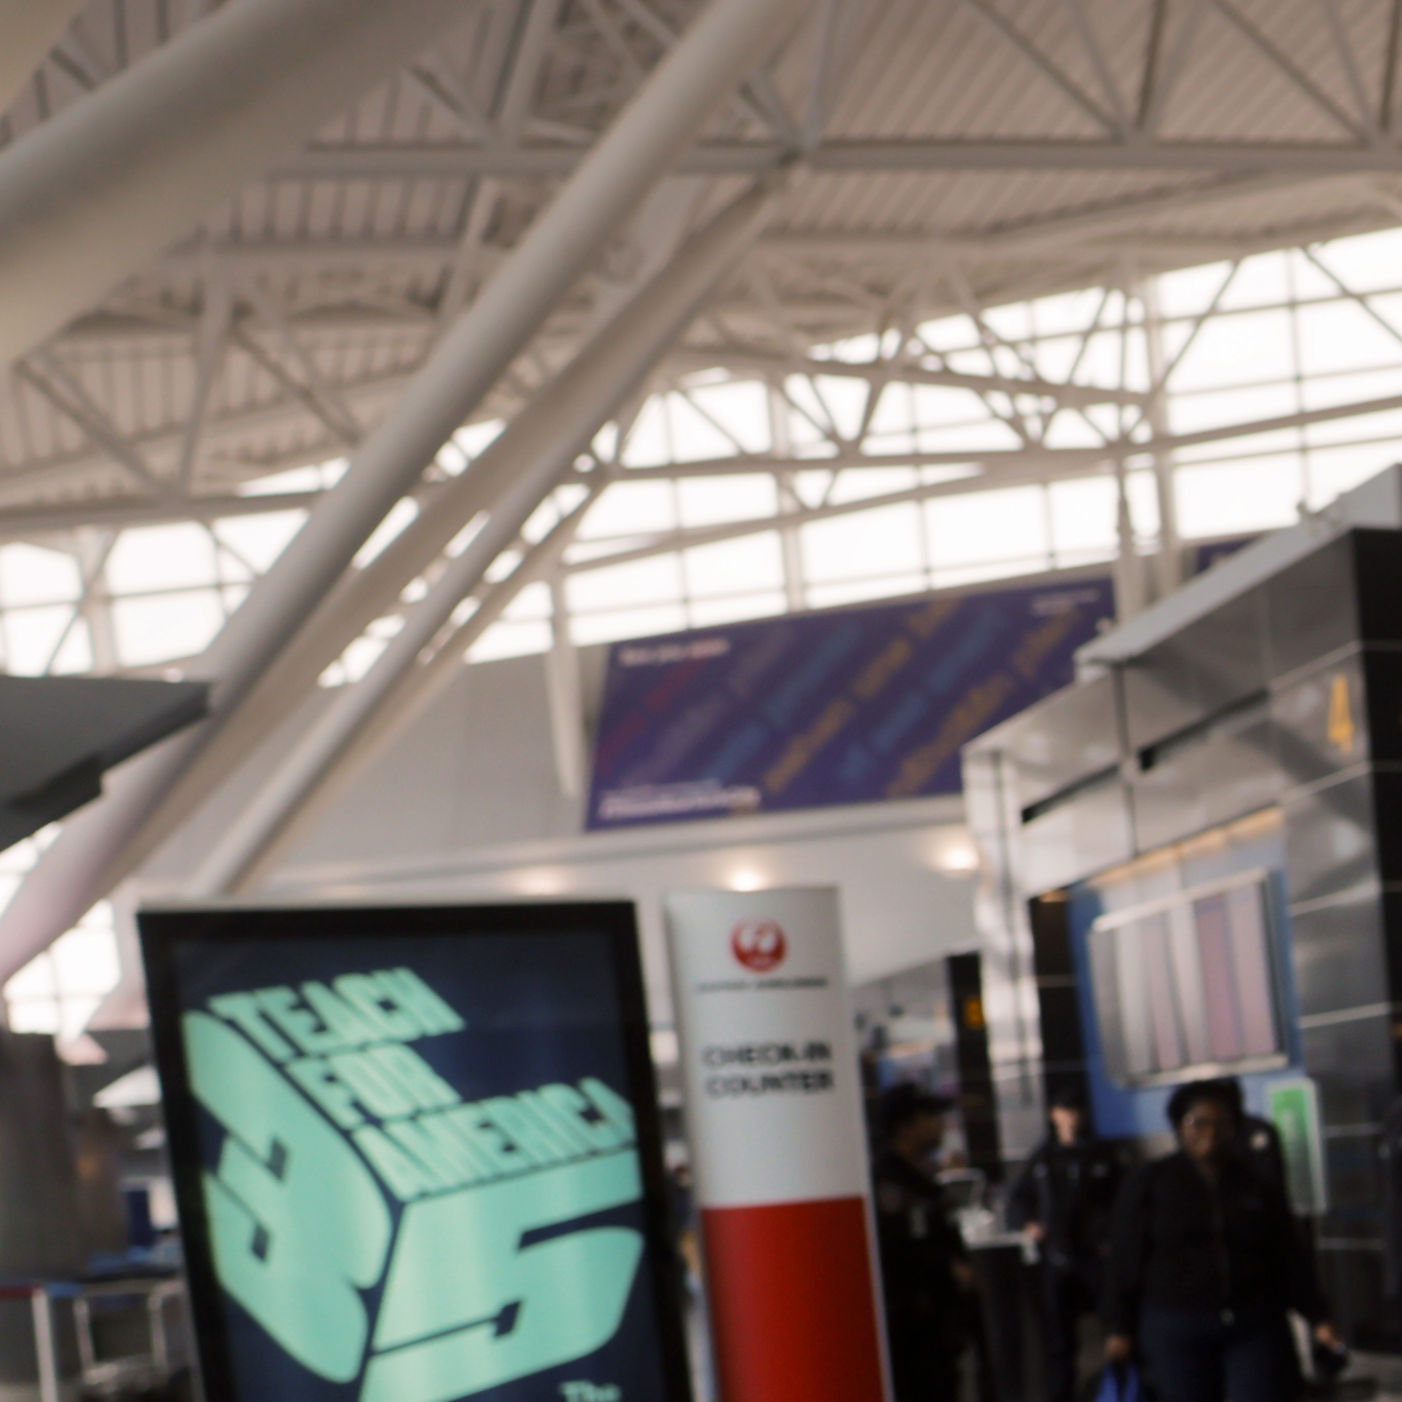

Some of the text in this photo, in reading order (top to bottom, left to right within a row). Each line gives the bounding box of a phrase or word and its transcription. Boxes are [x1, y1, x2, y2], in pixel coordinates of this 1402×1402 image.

[207, 966, 465, 1064] TEACH
[285, 1041, 463, 1131] FOR
[705, 1068, 834, 1099] COUNTER
[352, 1077, 638, 1201] AMERICA
